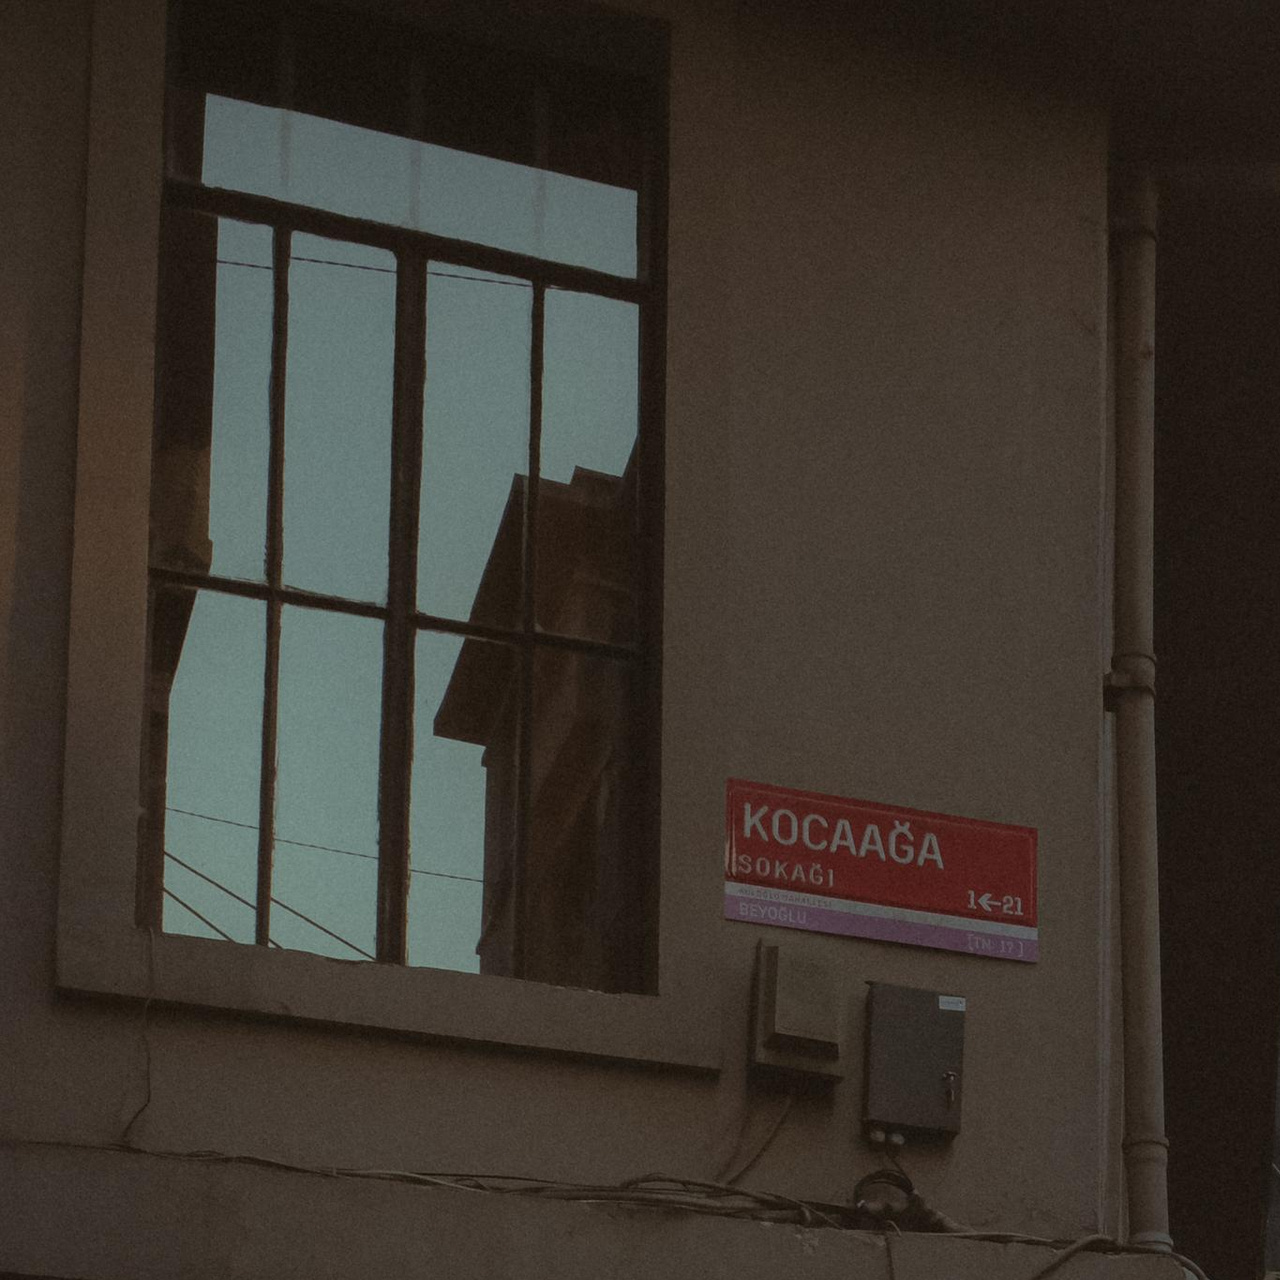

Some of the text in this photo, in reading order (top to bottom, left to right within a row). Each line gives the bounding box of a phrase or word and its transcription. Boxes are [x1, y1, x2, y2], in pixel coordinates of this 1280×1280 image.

[743, 802, 945, 870] KOCAAĞA
[738, 854, 835, 887] SOKAĞI
[739, 902, 807, 924] BEYOĞLU
